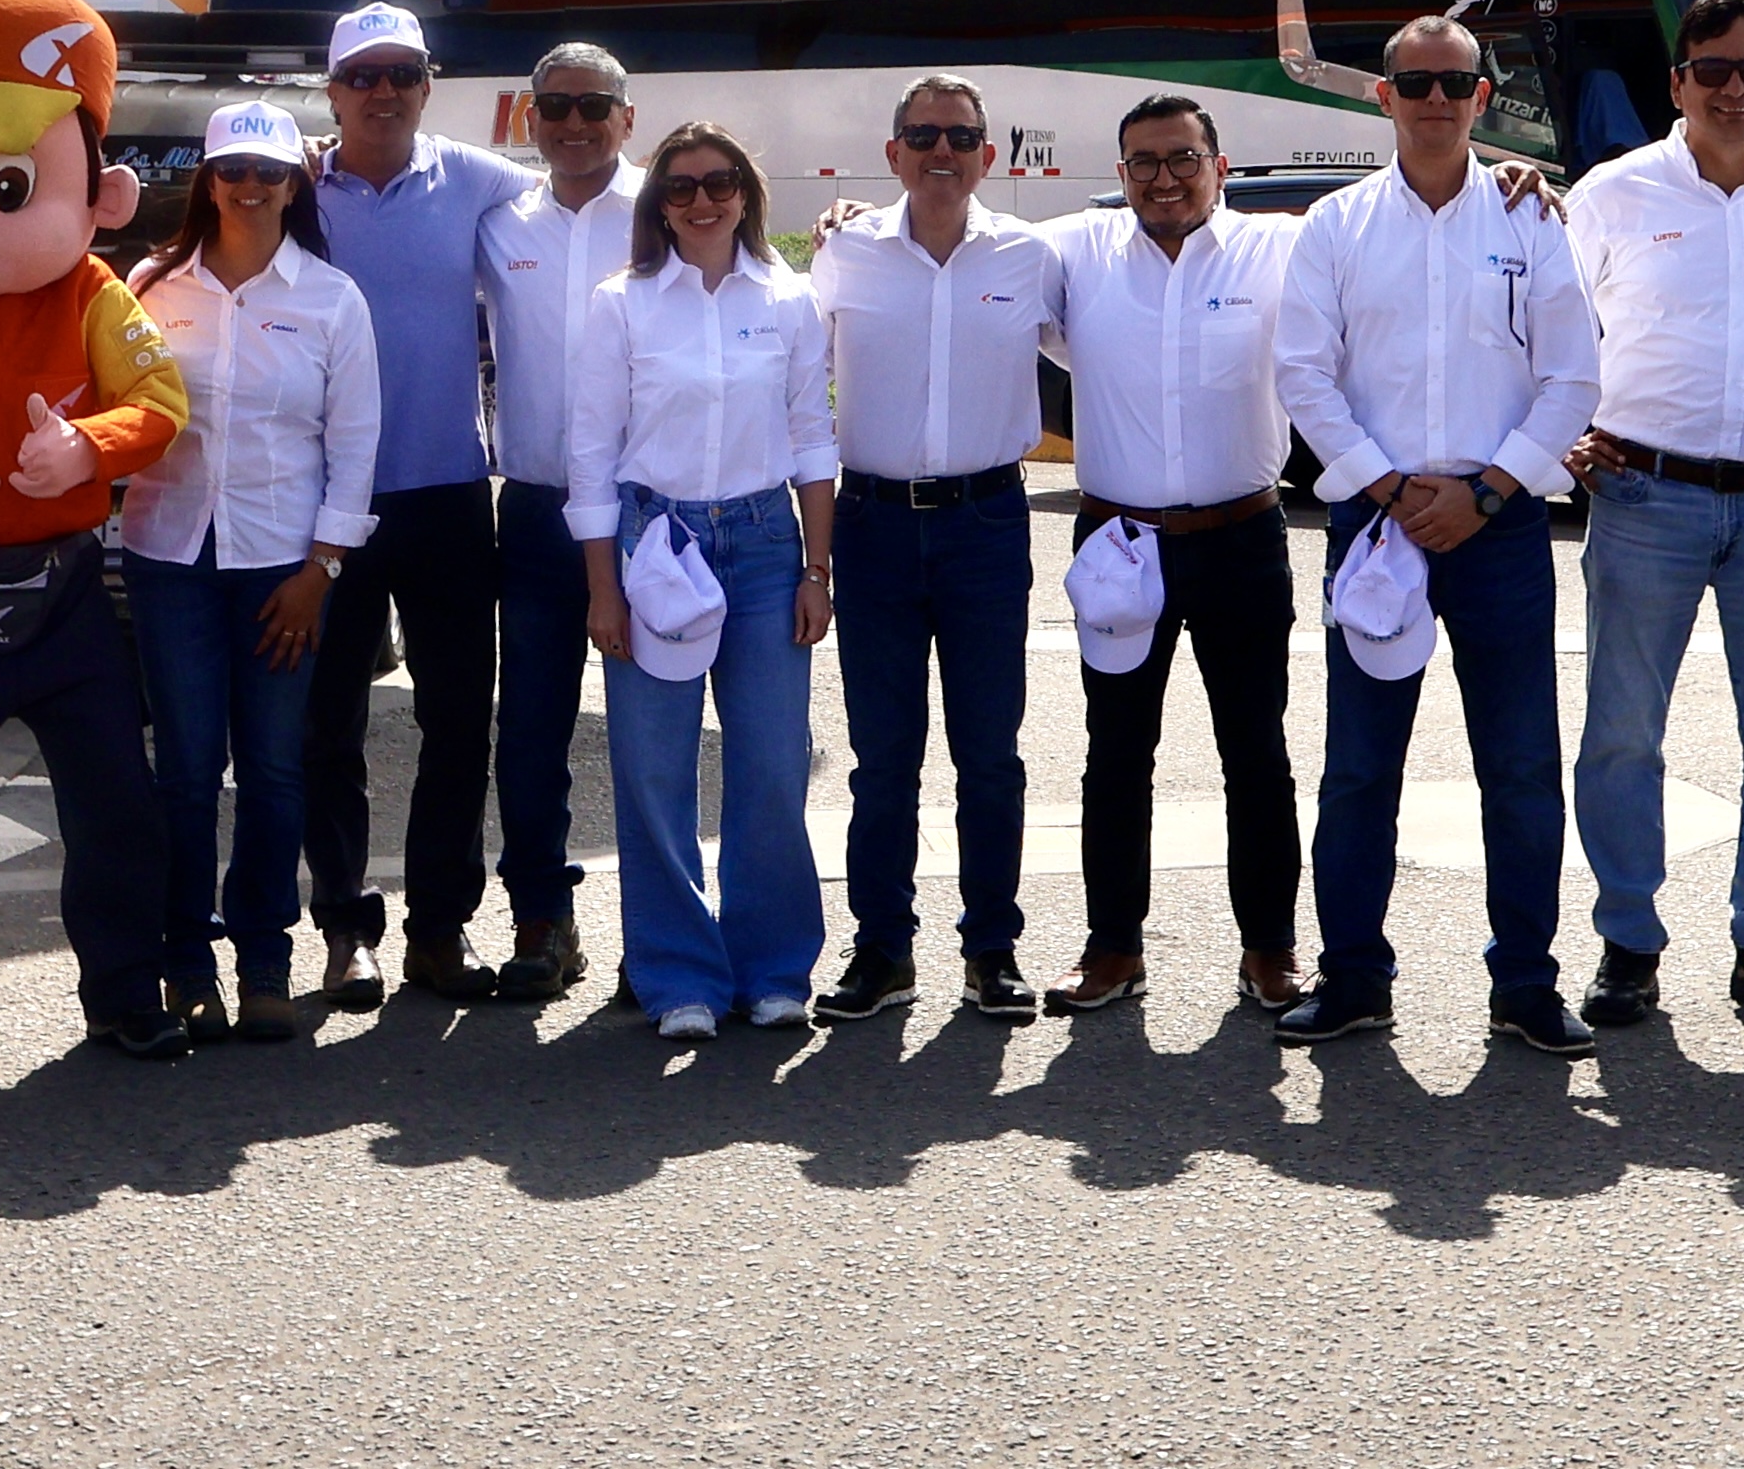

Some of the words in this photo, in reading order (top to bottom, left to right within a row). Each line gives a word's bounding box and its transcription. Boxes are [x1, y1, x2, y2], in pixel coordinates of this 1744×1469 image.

[230, 116, 275, 137] GNV
[1025, 129, 1056, 143] TURISMO
[1292, 151, 1375, 164] SERVICIO
